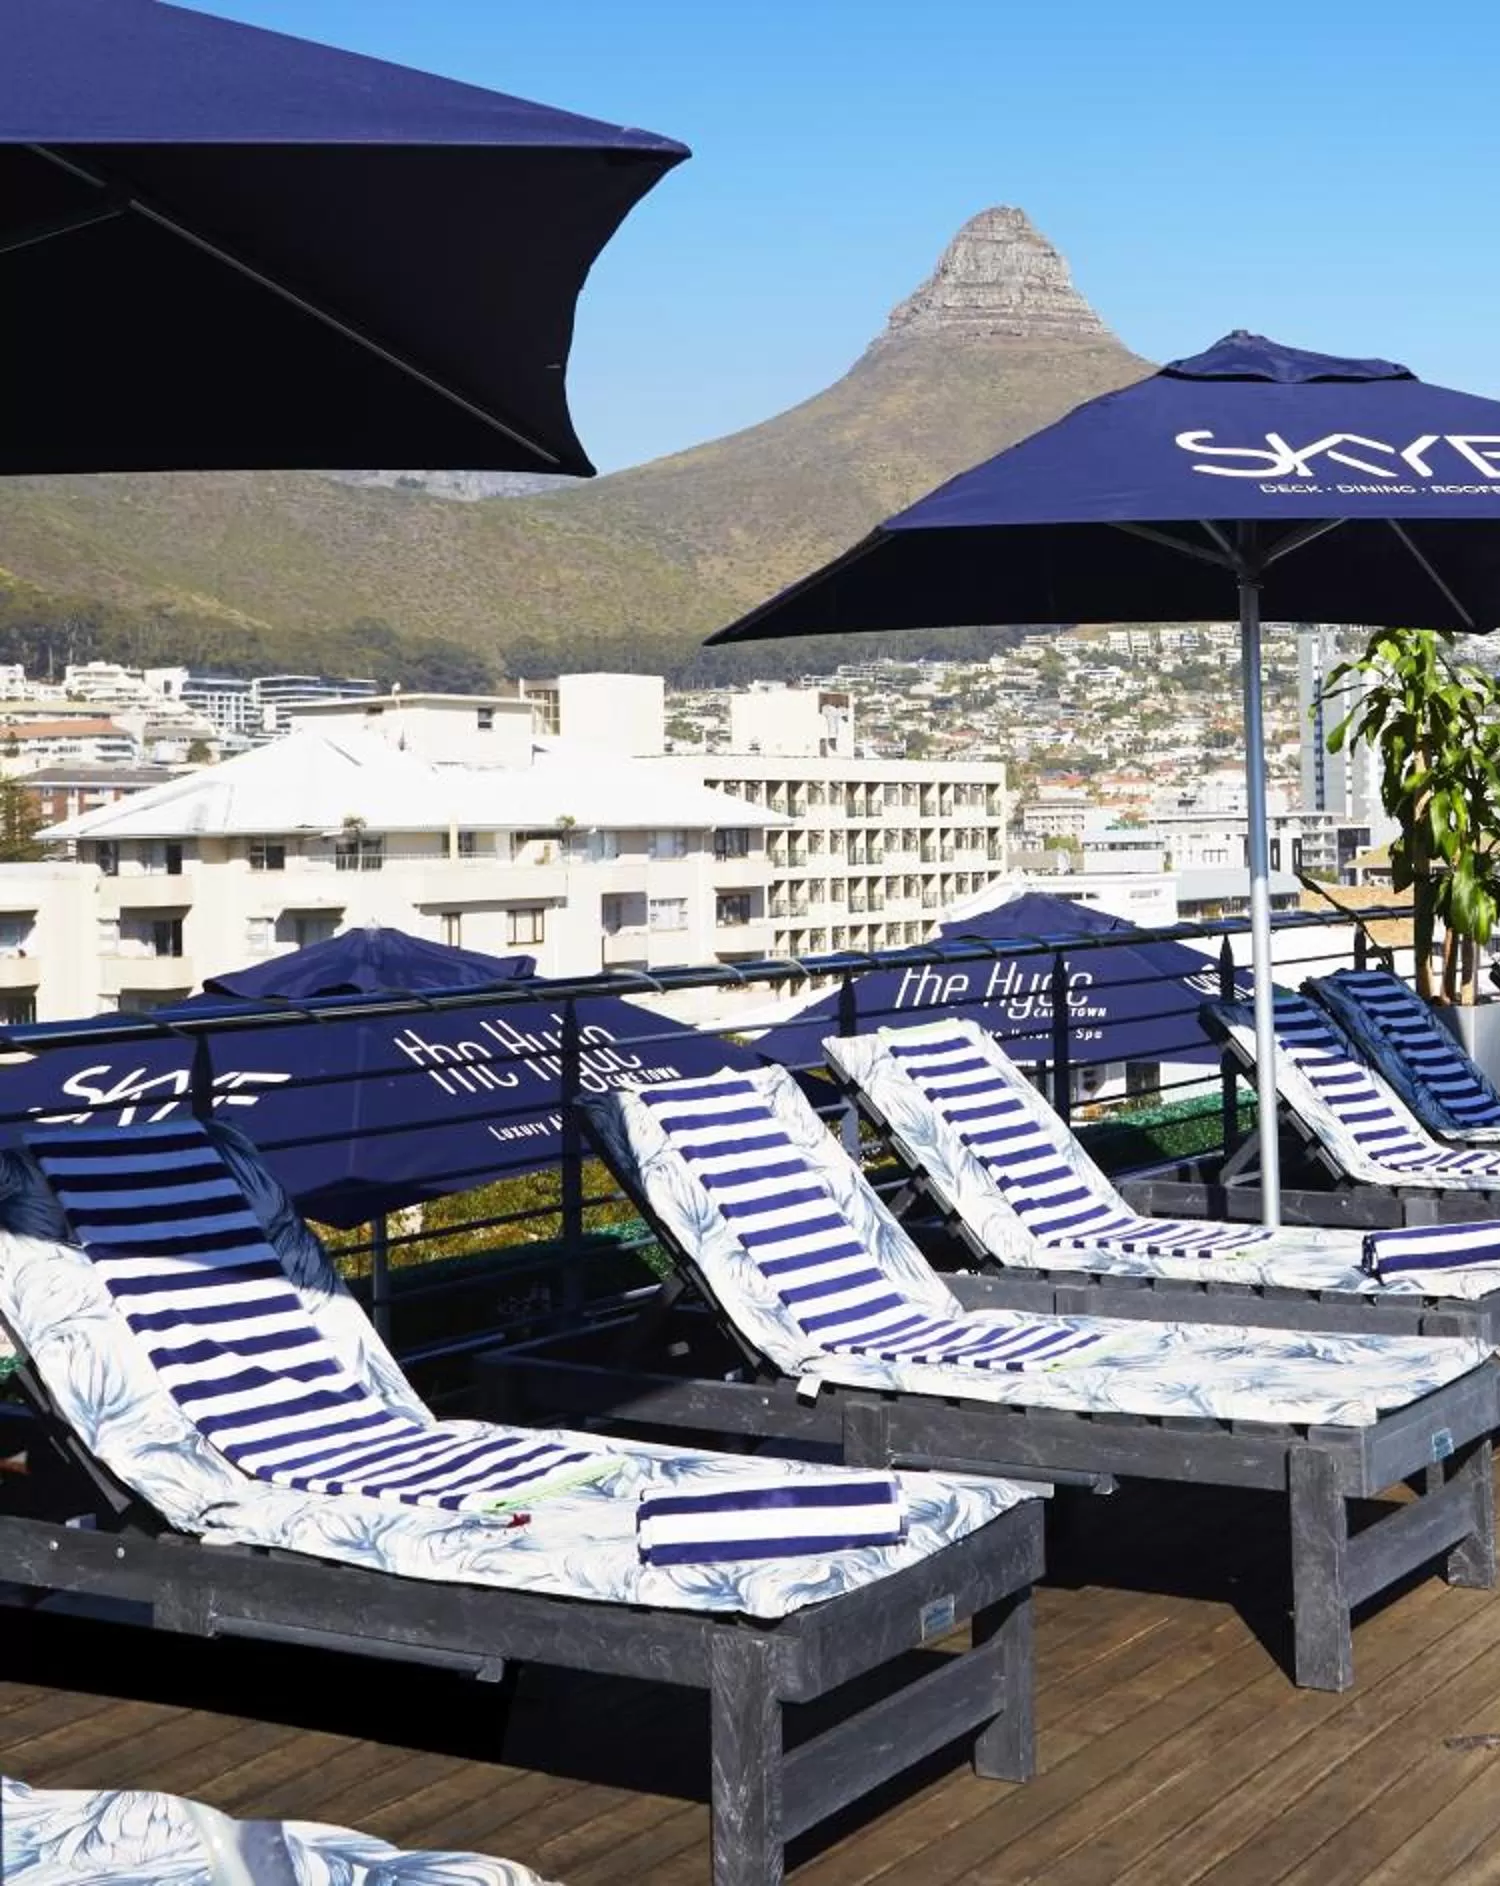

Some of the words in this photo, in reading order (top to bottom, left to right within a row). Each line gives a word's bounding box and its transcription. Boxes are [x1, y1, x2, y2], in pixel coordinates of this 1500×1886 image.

[1259, 484, 1323, 493] DECK
[1336, 484, 1416, 494] DINING
[895, 963, 970, 1009] the
[1071, 1007, 1108, 1018] TOWN
[1075, 1028, 1103, 1041] Spa
[393, 1028, 520, 1095] the
